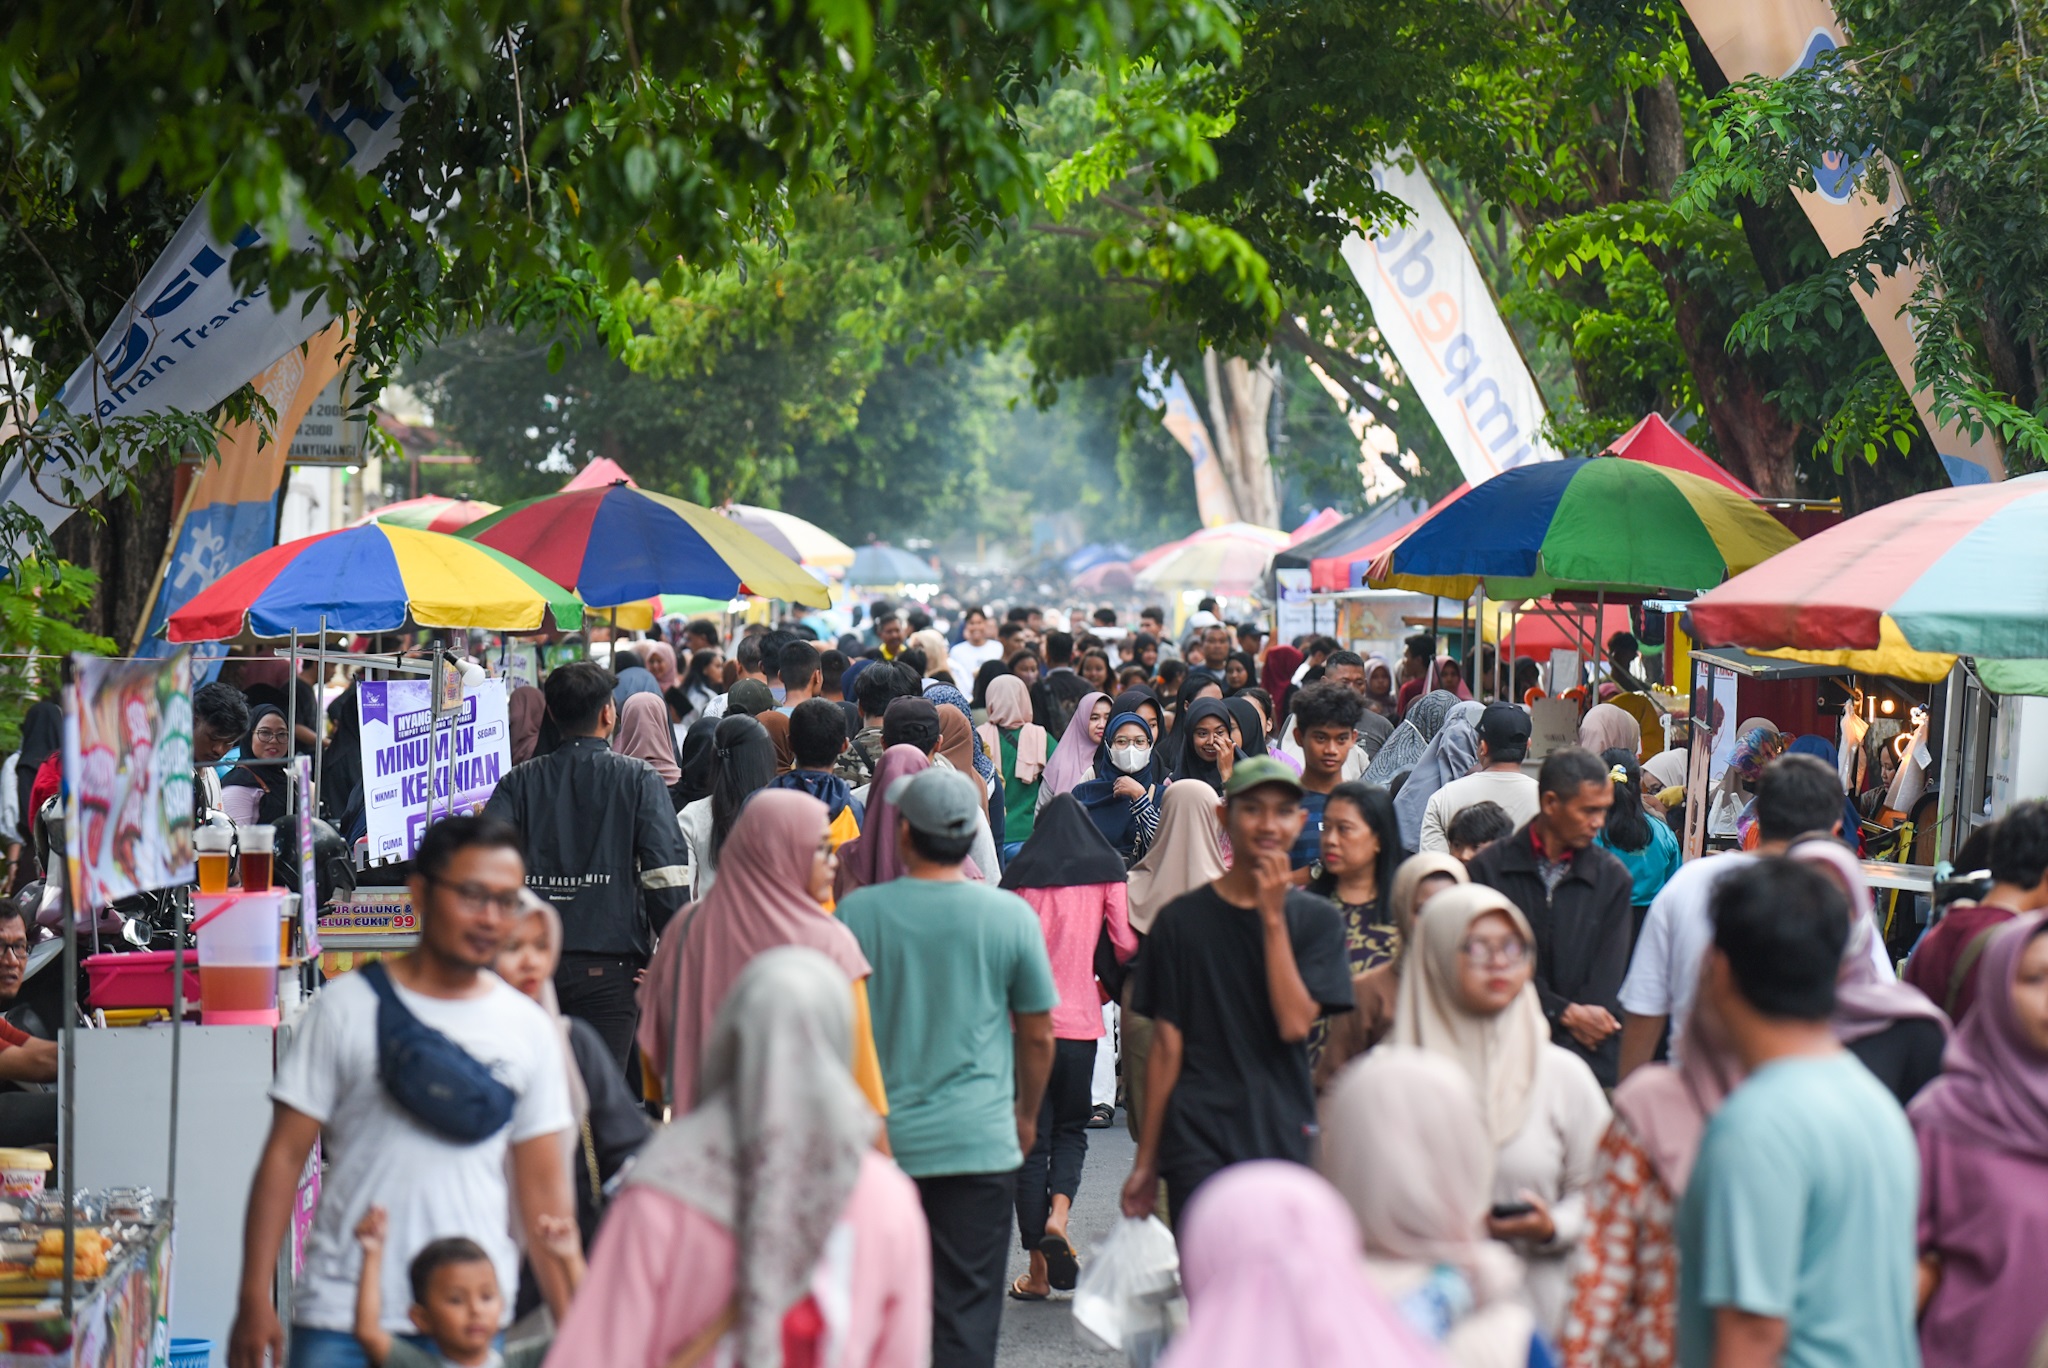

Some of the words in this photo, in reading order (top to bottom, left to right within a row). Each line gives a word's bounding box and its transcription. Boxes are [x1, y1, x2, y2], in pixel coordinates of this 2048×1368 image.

[398, 700, 472, 731] NYANG.ID
[477, 726, 497, 740] SEGAR
[402, 752, 500, 807] KEKINIAN
[375, 789, 398, 803] NIKMAT
[382, 837, 403, 851] CUMA
[525, 875, 543, 885] EAT
[353, 905, 401, 914] GULUNG
[404, 904, 412, 914] &
[318, 918, 351, 926] ELUR
[354, 917, 390, 926] CUKIT
[393, 915, 415, 927] 99
